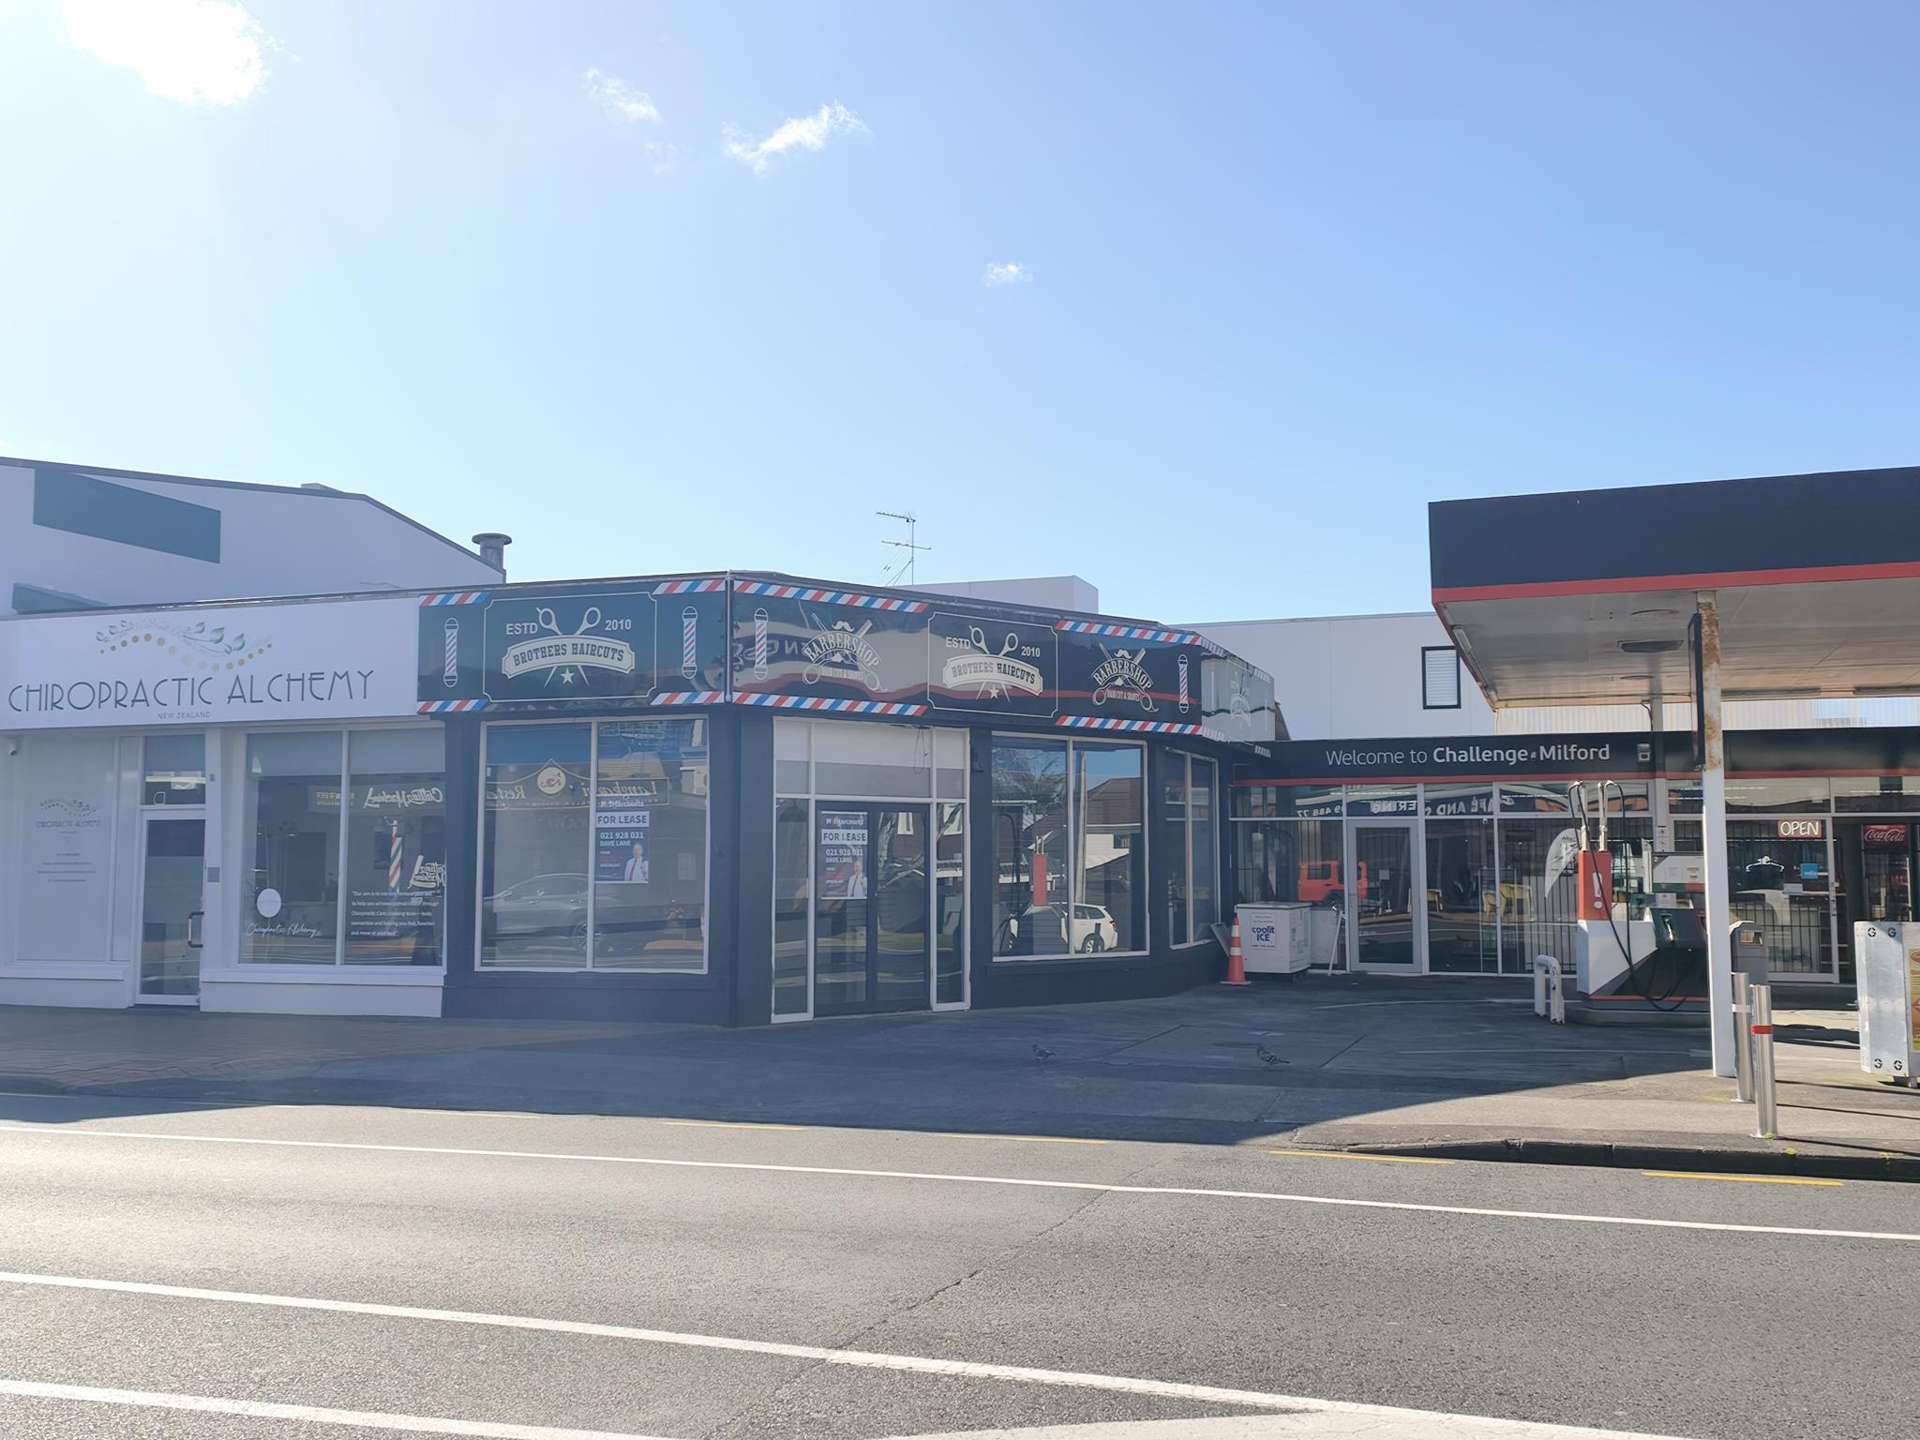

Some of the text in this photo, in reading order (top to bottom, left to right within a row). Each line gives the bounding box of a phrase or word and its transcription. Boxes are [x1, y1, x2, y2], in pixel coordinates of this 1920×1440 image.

[505, 618, 632, 636] ESTD 2010
[512, 643, 624, 666] BROTHERS HAIRCUTS
[803, 631, 881, 667] BARBERSHOP
[945, 636, 1041, 657] ESTD 2010
[951, 661, 1036, 684] BROTHERS HAIRCUTS
[1093, 658, 1154, 689] BARBERSHOP
[8, 670, 375, 713] CHIROPRACTIC ALCHEMY
[1326, 744, 1610, 766] Welcome to Challenge Milford
[597, 815, 647, 825] FOR LEASE
[1780, 821, 1819, 836] OPEN
[823, 832, 866, 842] FOR LEASE
[1256, 933, 1270, 942] ICE
